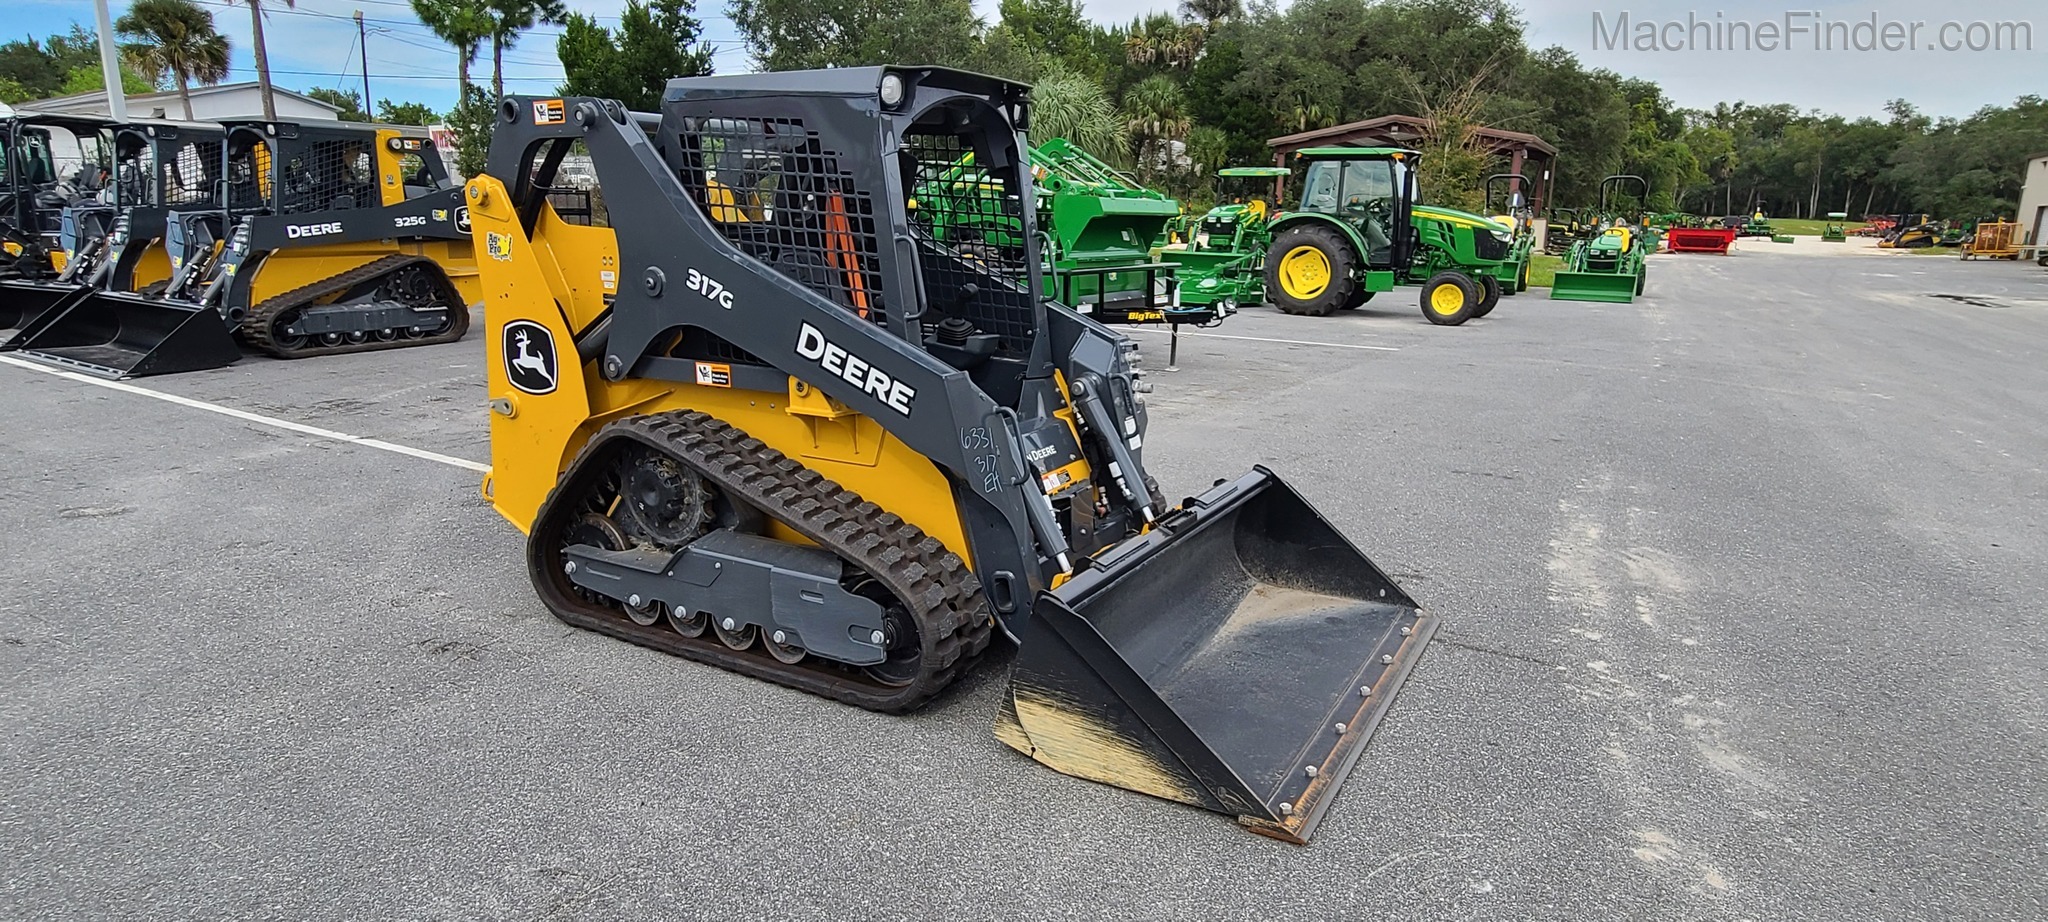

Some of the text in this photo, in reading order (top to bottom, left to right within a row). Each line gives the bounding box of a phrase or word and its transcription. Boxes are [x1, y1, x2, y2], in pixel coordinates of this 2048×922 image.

[287, 222, 344, 239] DEERE
[394, 216, 427, 228] 325G
[685, 267, 735, 310] 317G
[1127, 311, 1162, 322] BigTex
[795, 321, 916, 416] DEERE
[1030, 444, 1058, 461] DEERE
